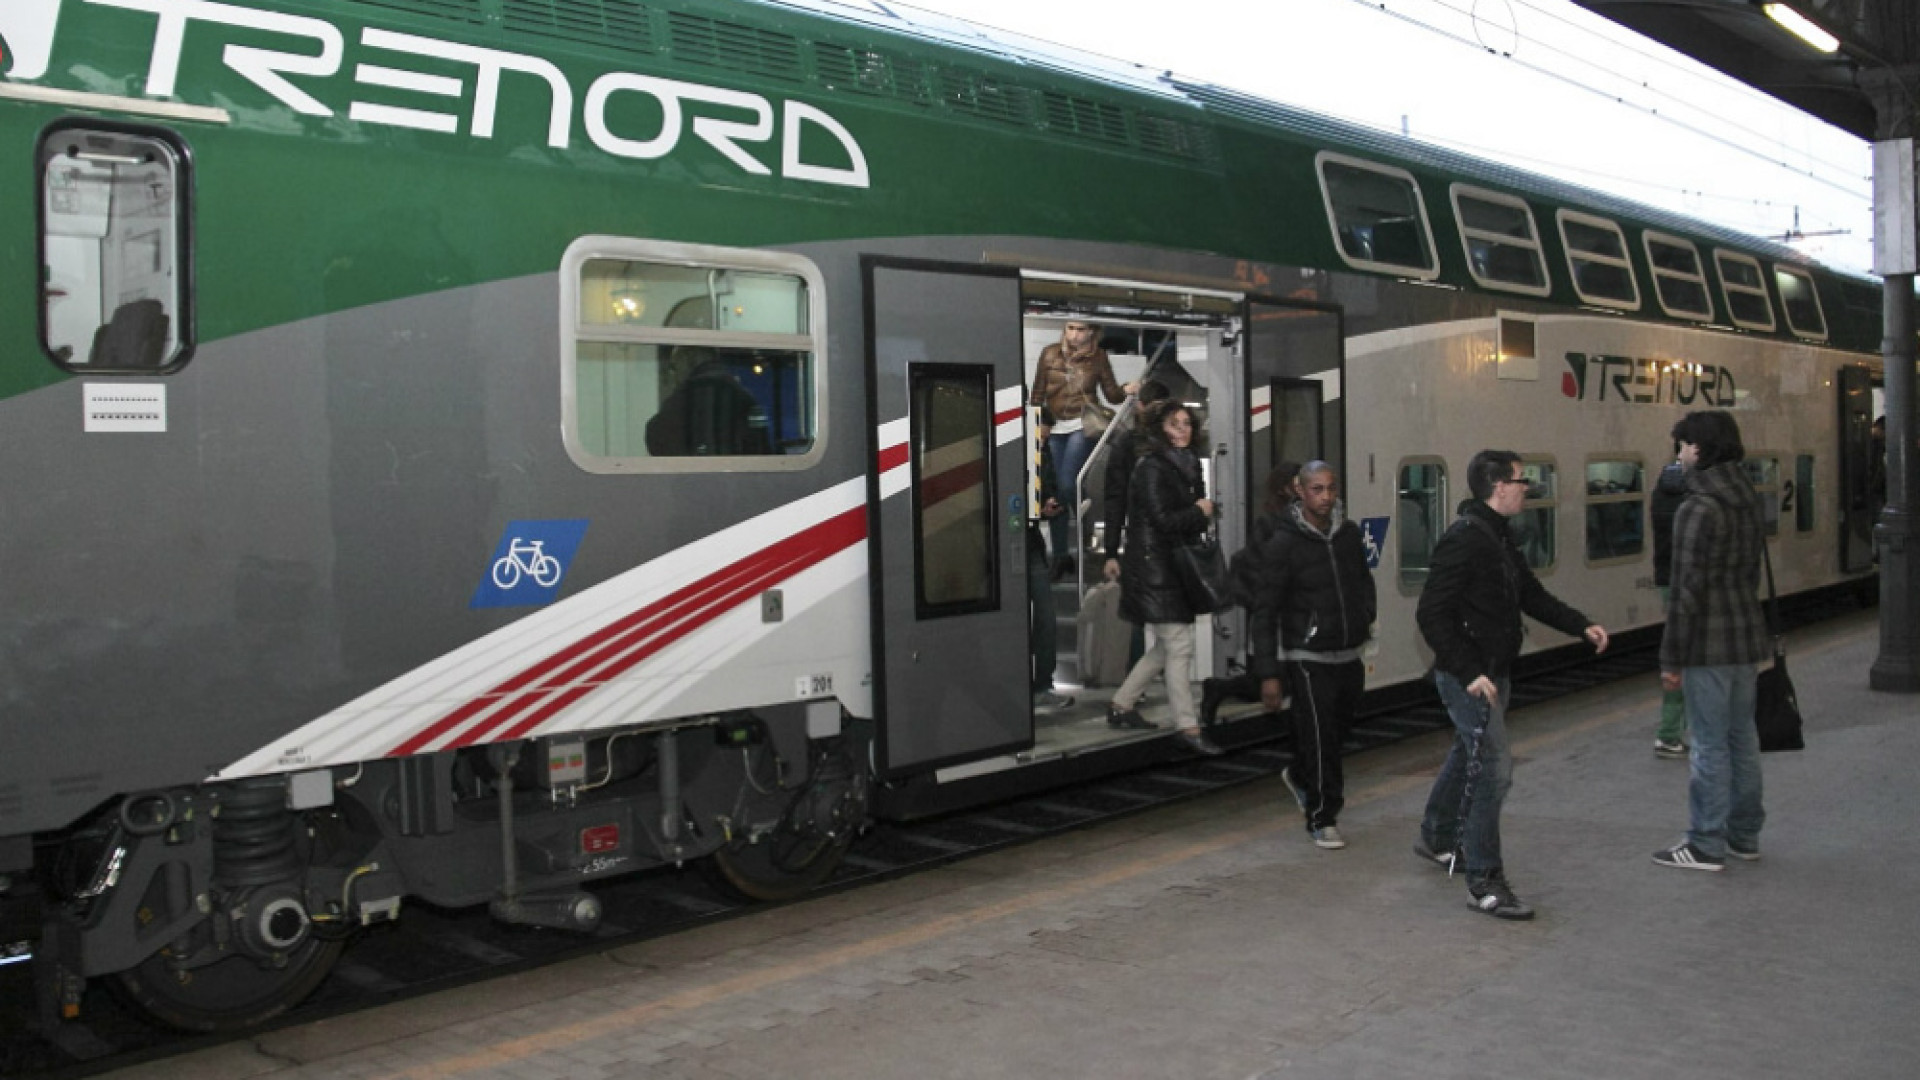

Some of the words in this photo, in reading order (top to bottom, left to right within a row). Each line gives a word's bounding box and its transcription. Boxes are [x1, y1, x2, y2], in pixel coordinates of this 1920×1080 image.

[84, 0, 870, 187] TRENORD
[1590, 354, 1736, 408] TRENORD
[1781, 479, 1794, 513] 2
[812, 674, 833, 693] 201
